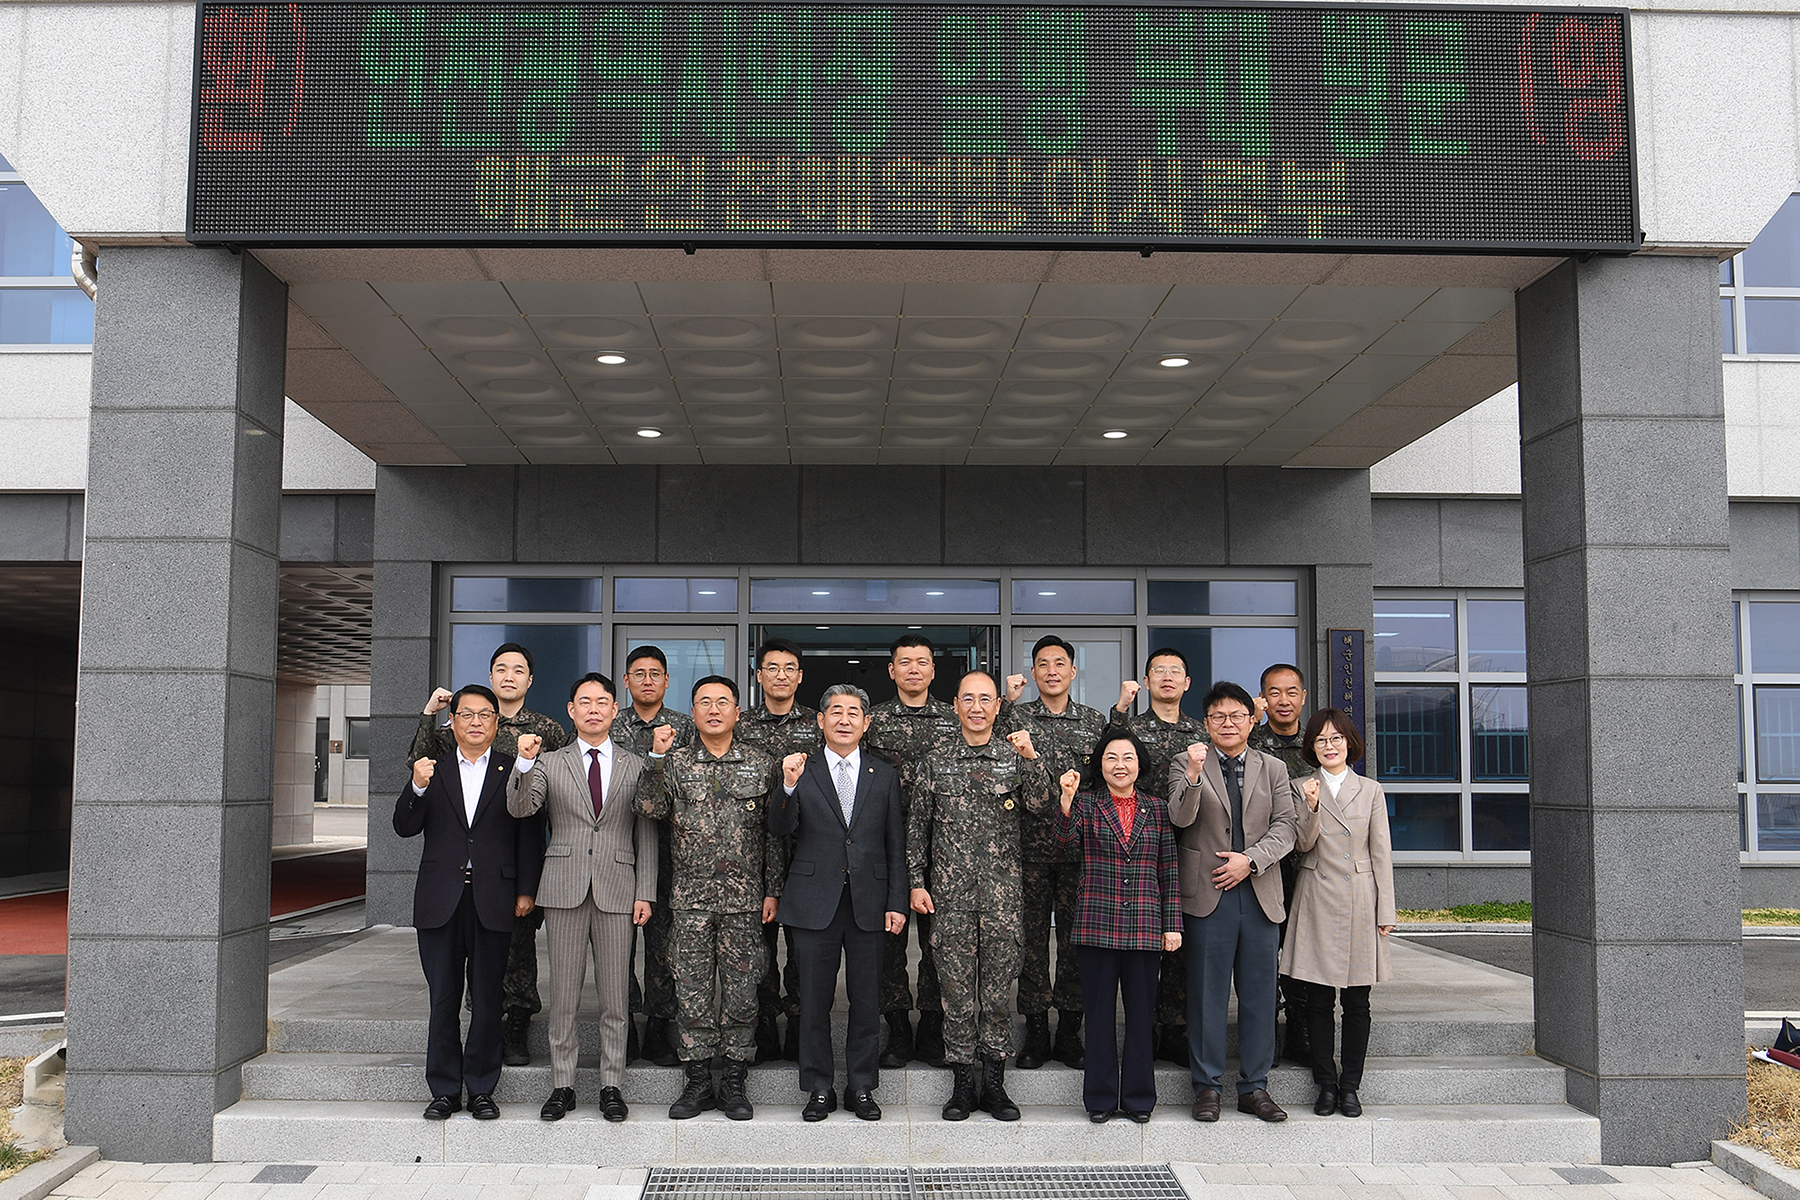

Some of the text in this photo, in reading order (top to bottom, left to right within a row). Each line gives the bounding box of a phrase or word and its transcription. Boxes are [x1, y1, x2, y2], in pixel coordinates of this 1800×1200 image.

[358, 8, 896, 156] 인천광역시의장
[936, 11, 1088, 154] 일행
[1130, 12, 1271, 157] 부대
[1321, 14, 1469, 158] 방문
[475, 155, 1351, 238] 해군인천해역방어사령부
